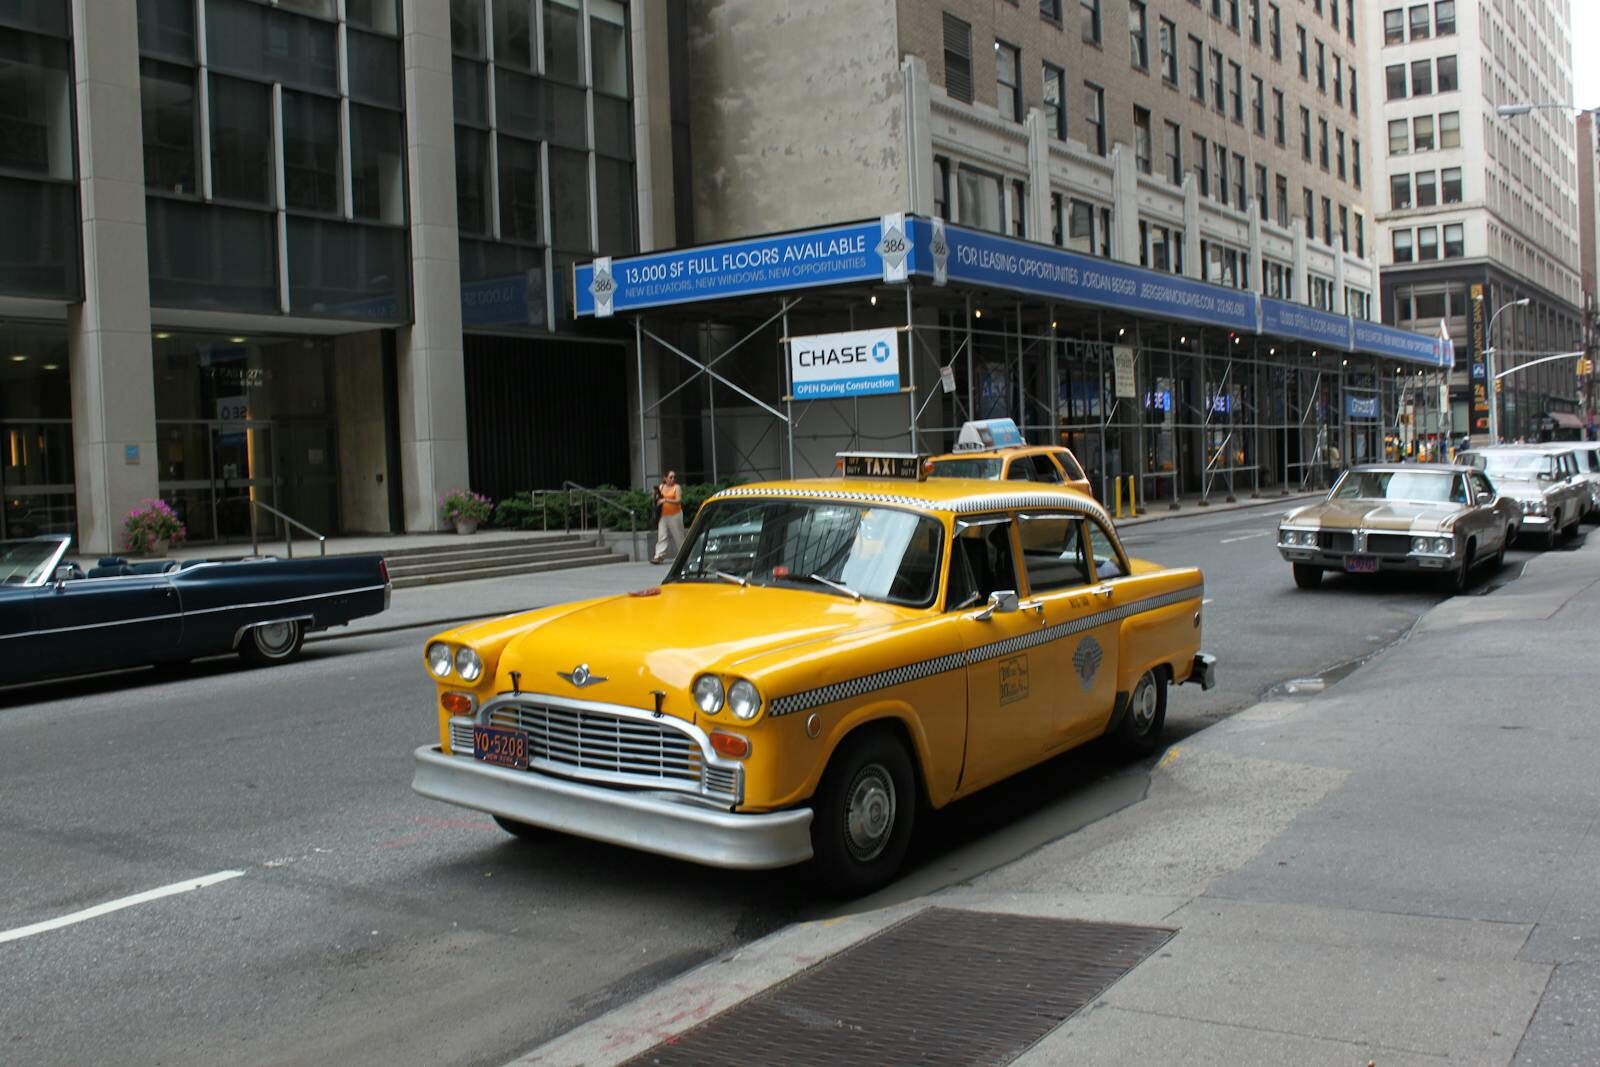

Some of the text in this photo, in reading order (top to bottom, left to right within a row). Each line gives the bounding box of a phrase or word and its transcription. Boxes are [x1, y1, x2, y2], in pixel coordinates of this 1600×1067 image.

[883, 238, 905, 252] 386
[625, 235, 866, 284] 13,000 SF FULL FLOORS AVAILABLE
[625, 256, 867, 298] NEW ELEVATORS, NEW WINDOWS, NEW OPPORTUNITIES
[957, 245, 977, 265] FOR
[979, 249, 1017, 274] LEASING
[1019, 257, 1079, 287] OPPORTUNITIES
[1081, 271, 1111, 292] JORDAN
[1112, 276, 1136, 296] BERGER
[594, 279, 612, 293] 386
[798, 344, 868, 368] CHASE
[797, 377, 895, 396] OPEN During Construction
[846, 466, 861, 474] DUTY
[864, 457, 896, 476] TAXI
[901, 468, 916, 477] DUTY
